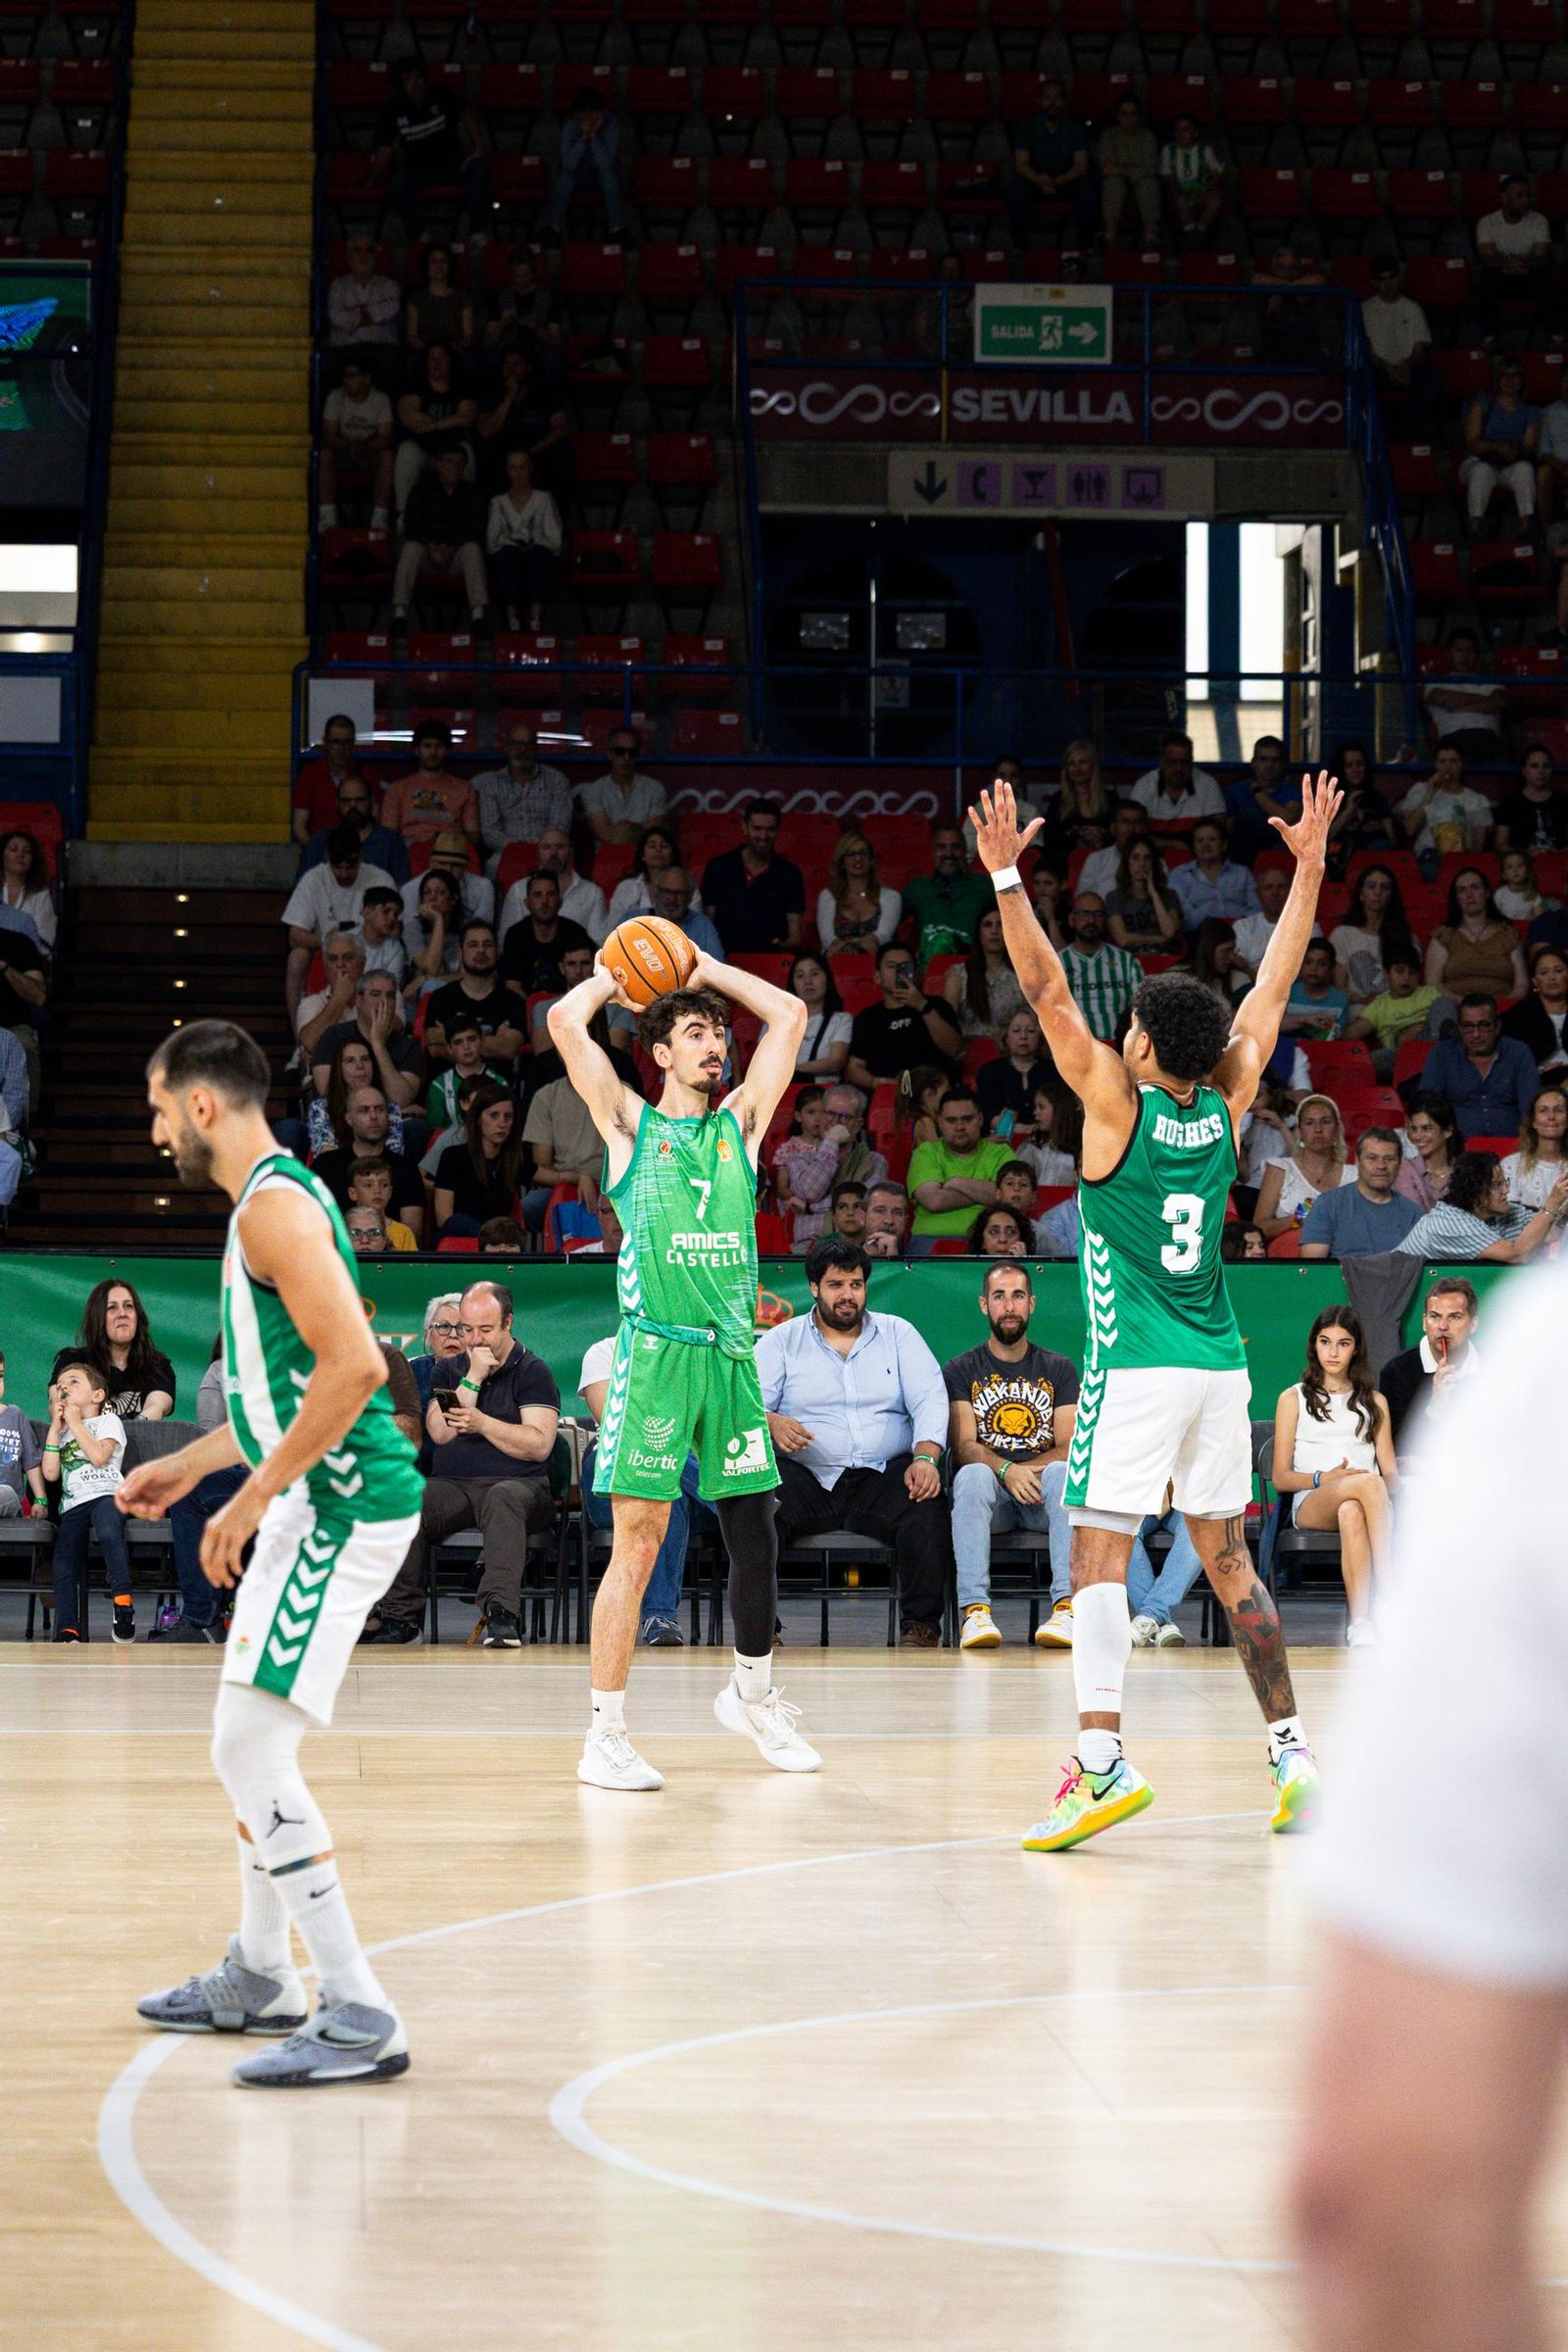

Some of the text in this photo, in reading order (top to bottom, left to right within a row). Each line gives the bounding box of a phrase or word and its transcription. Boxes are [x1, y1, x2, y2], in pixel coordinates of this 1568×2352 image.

[991, 324, 1035, 339] SALIDA
[952, 386, 1135, 423] SEVILLA
[689, 1178, 711, 1219] 7
[670, 1231, 741, 1250] AMICS
[1160, 1193, 1206, 1274] 3
[972, 1382, 1054, 1424] WAKANDA
[626, 1448, 679, 1470] ibertic
[635, 1470, 662, 1479] telecom
